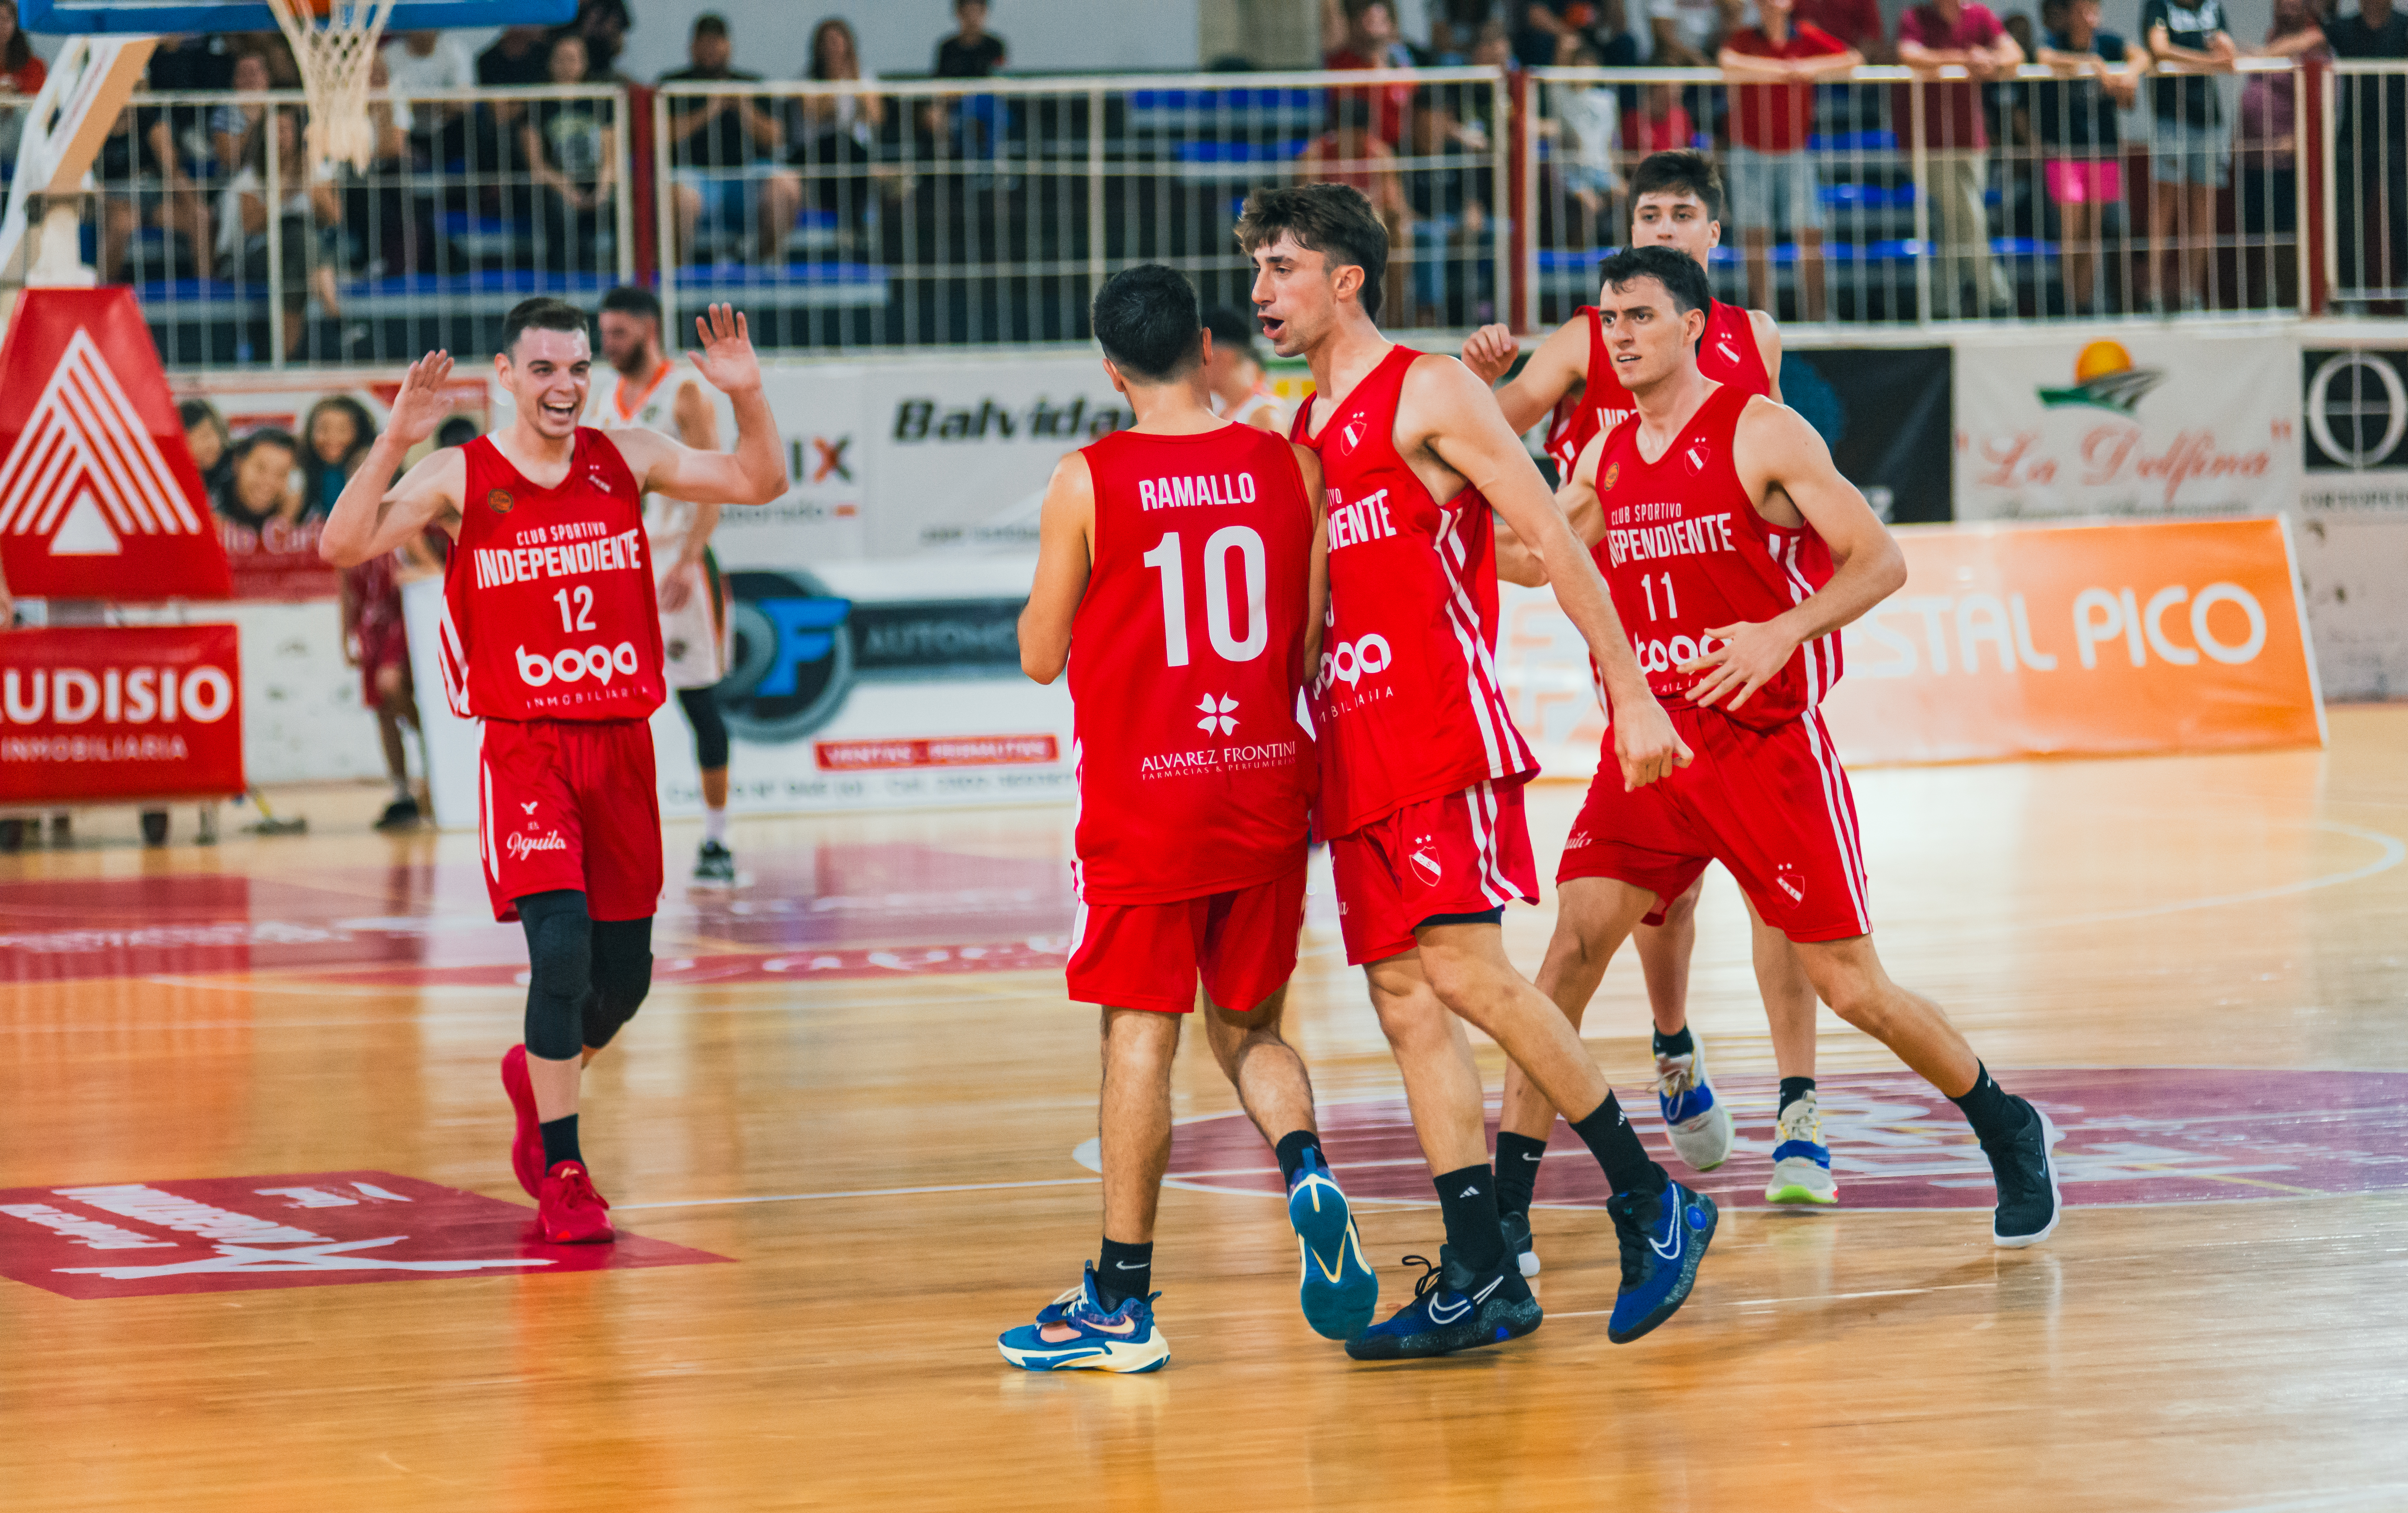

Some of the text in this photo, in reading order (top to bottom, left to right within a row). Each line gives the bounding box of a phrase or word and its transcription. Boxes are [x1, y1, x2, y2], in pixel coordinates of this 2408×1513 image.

[1139, 472, 1256, 511] RAMALLO
[1611, 502, 1682, 526] CLUB SPORTIVO
[516, 522, 608, 546] CLUB SPORTIVO
[474, 528, 641, 590] INDEPENDIENTE
[553, 585, 596, 633] 12
[1143, 525, 1268, 667] 10
[1641, 571, 1678, 622] 11
[2073, 582, 2267, 669] PICO
[1, 666, 233, 724] UDISIO
[1141, 741, 1296, 772] ALVAREZ FRONTINI
[1143, 766, 1209, 780] FARMACIAS
